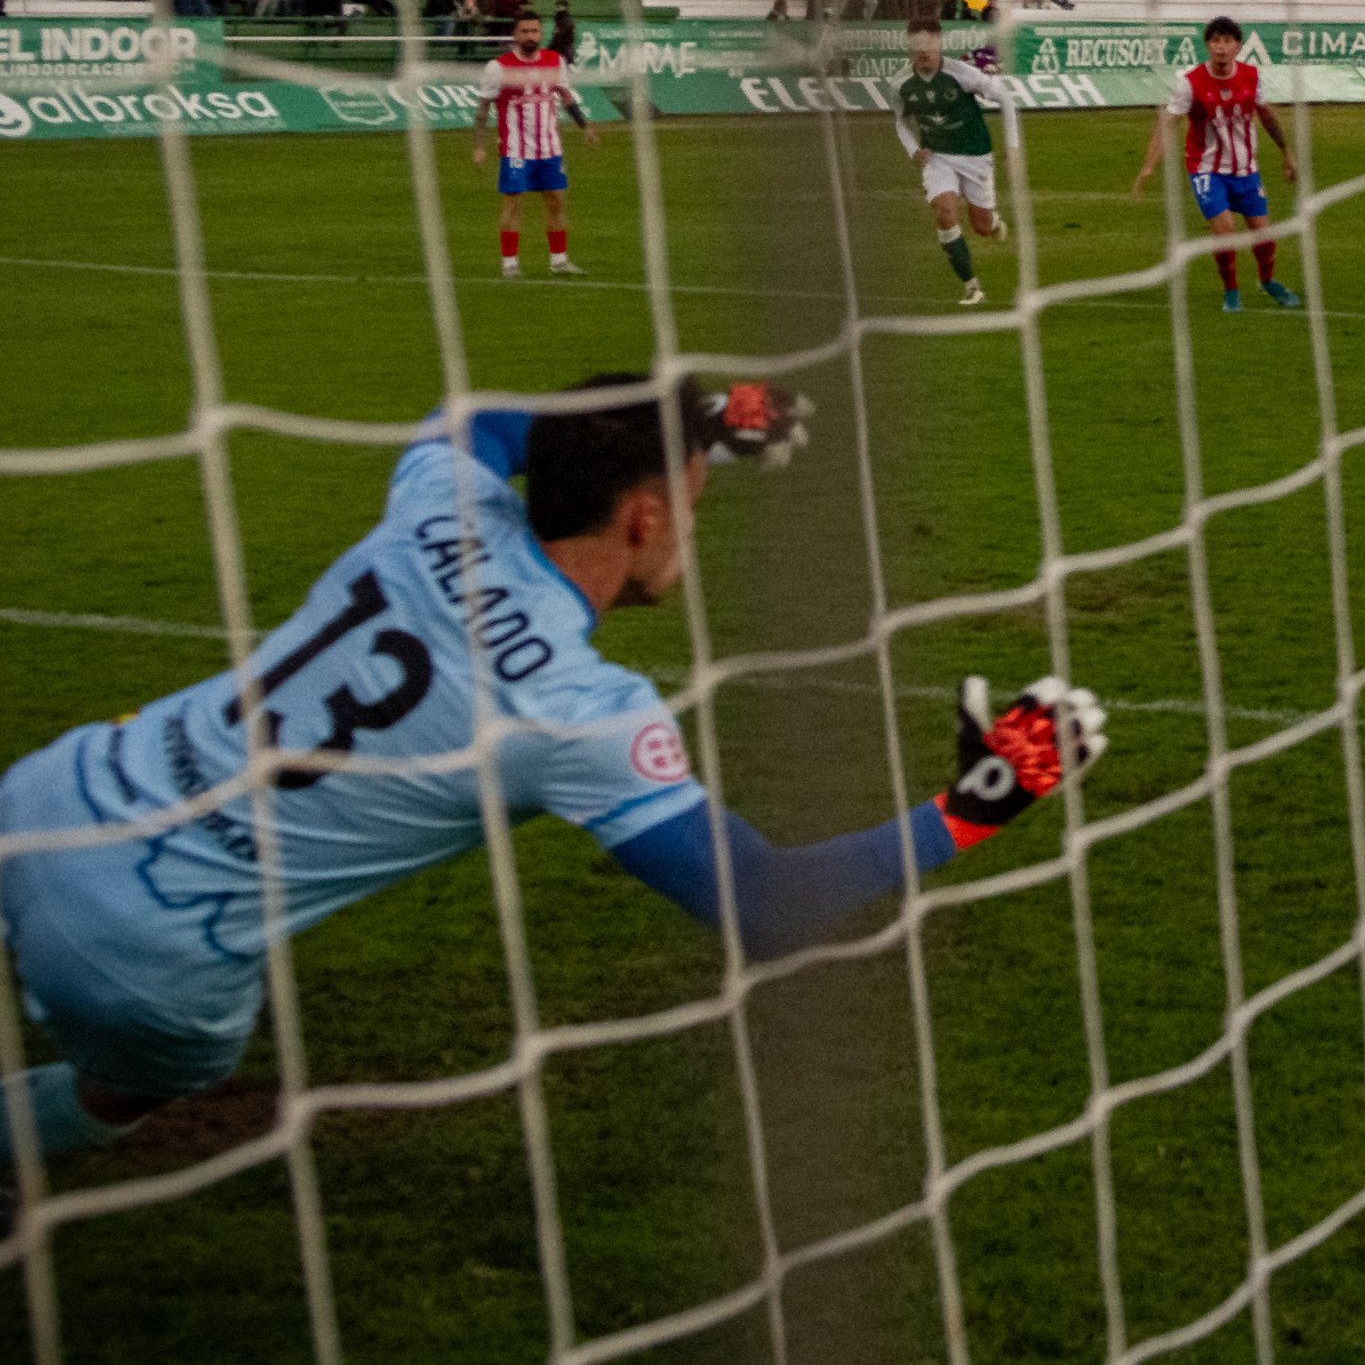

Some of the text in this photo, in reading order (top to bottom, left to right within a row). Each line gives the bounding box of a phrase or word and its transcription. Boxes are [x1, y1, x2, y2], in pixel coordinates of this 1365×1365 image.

[41, 27, 197, 61] INDOOR
[28, 82, 281, 124] albroksa
[224, 570, 437, 791] 13
